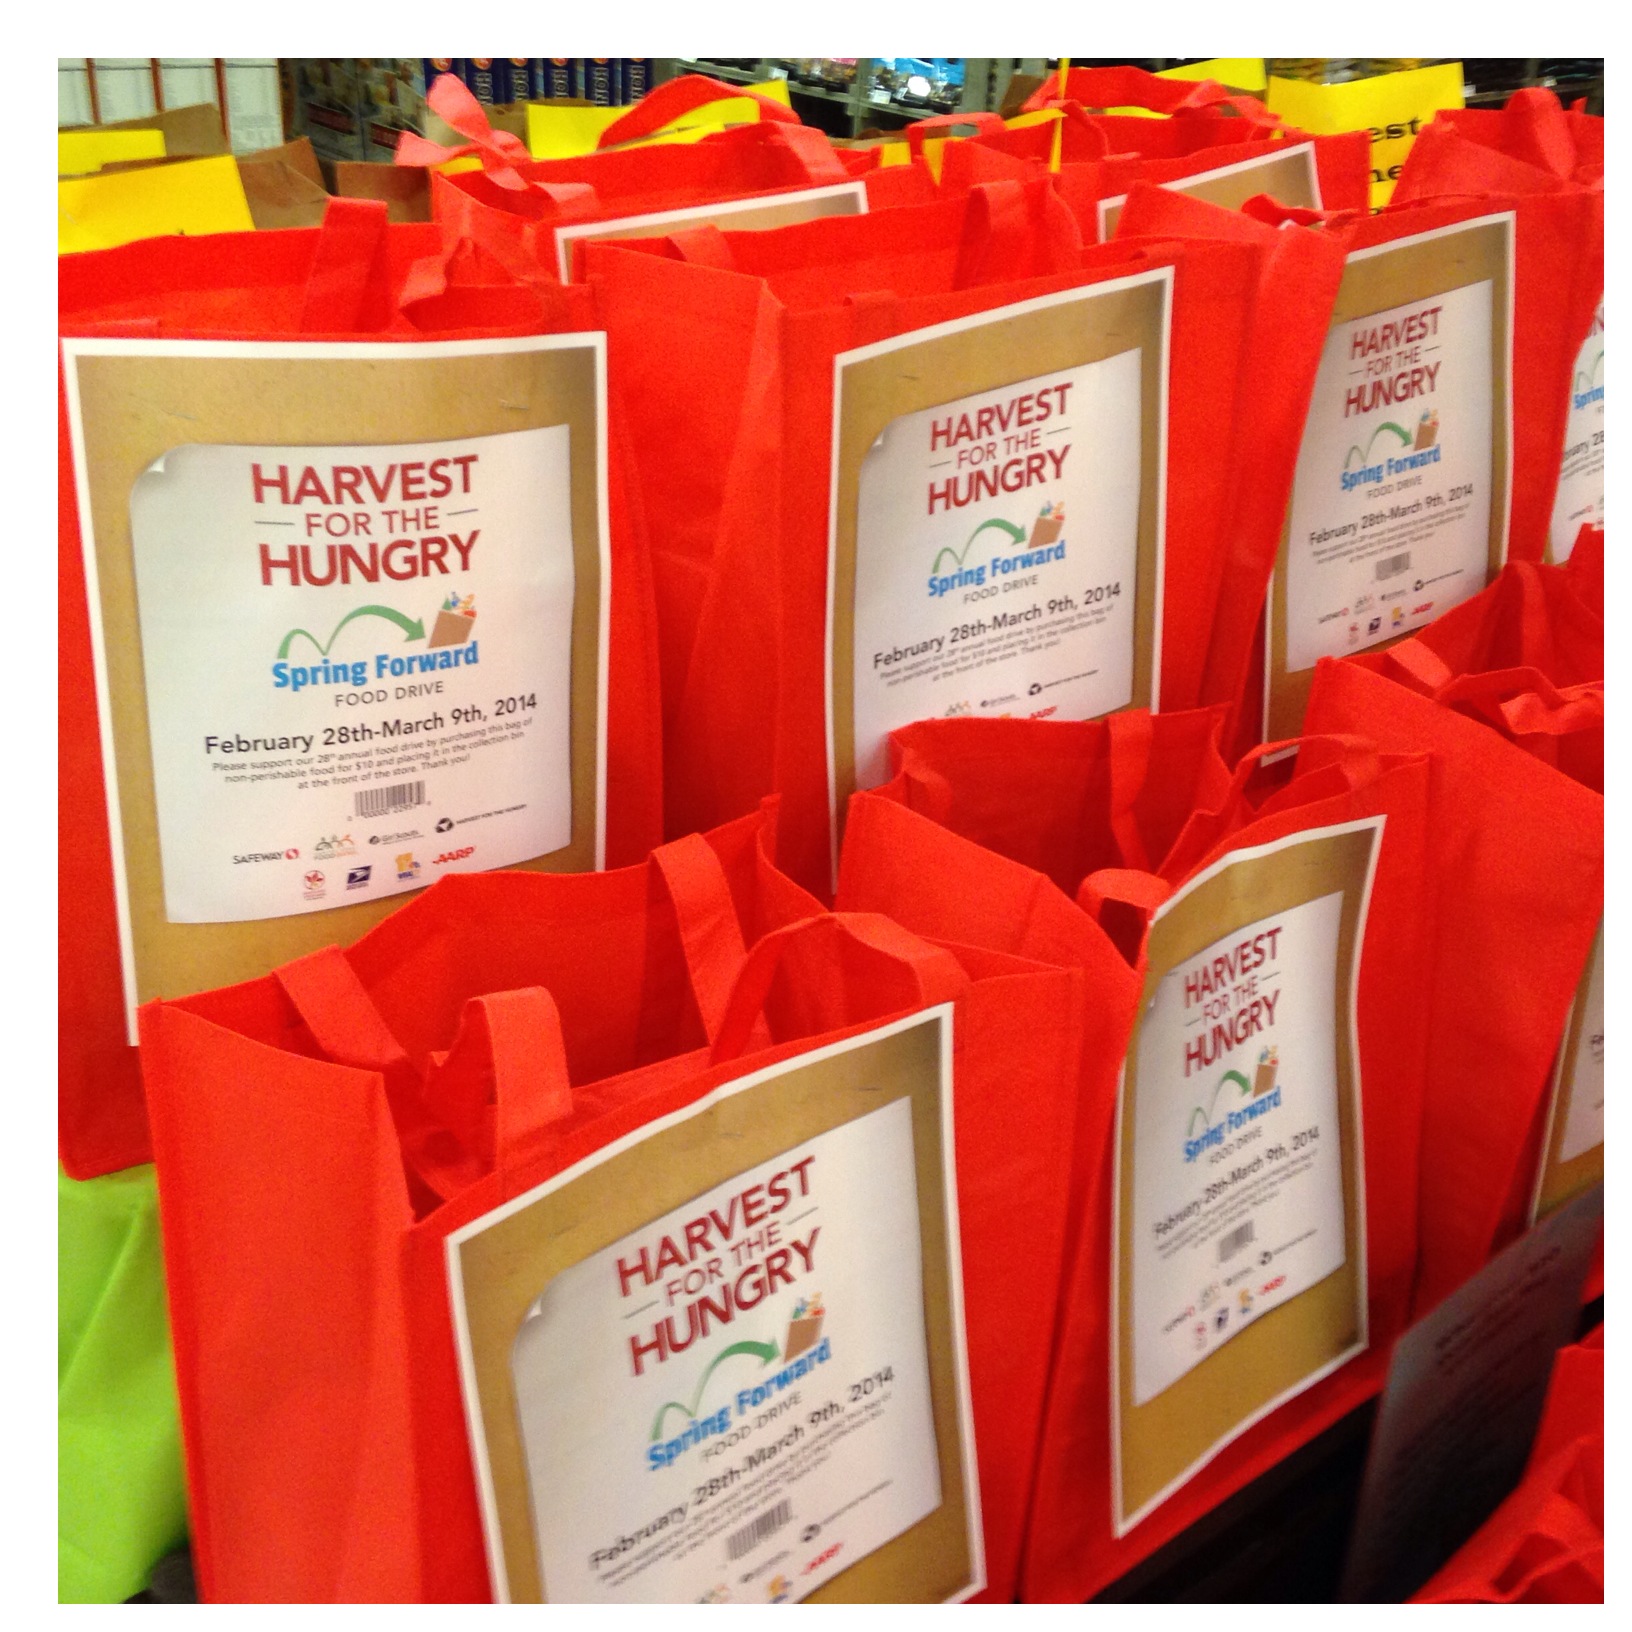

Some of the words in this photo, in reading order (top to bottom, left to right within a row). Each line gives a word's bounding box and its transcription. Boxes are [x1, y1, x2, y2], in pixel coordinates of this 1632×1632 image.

[1351, 306, 1442, 360] HARVEST
[1367, 356, 1391, 376] FOR
[1397, 346, 1421, 367] THE
[931, 382, 1073, 451] HARVEST
[1345, 361, 1442, 418] HUNGRY
[957, 442, 998, 469] FOR
[1003, 428, 1041, 455] THE
[1341, 465, 1384, 491] Spring
[1387, 444, 1441, 475] Forward
[251, 454, 478, 504] HARVEST
[928, 444, 1071, 515] HUNGRY
[306, 512, 371, 537] FOR
[381, 506, 439, 534] THE
[259, 530, 481, 586] HUNGRY
[928, 562, 985, 597] Spring
[990, 539, 1066, 579] Forward
[963, 586, 999, 604] FOOD
[1002, 574, 1039, 595] DRIVE
[272, 658, 367, 691] Spring
[376, 640, 478, 678] Forward
[335, 690, 389, 708] FOOD
[395, 680, 444, 700] DRIVE
[205, 732, 314, 755] February
[323, 711, 444, 747] 28th-March
[451, 704, 488, 725] 9th,
[494, 693, 538, 717] 2014
[1184, 926, 1282, 1009] HARVEST
[1184, 989, 1281, 1078] HUNGRY
[1227, 1086, 1282, 1132] Forward
[617, 1155, 816, 1298] HARVEST
[665, 1258, 725, 1306] FOR
[731, 1222, 781, 1266] THE
[628, 1227, 821, 1377] HUNGRY
[647, 1407, 730, 1471] Spring
[736, 1337, 831, 1415] Forward
